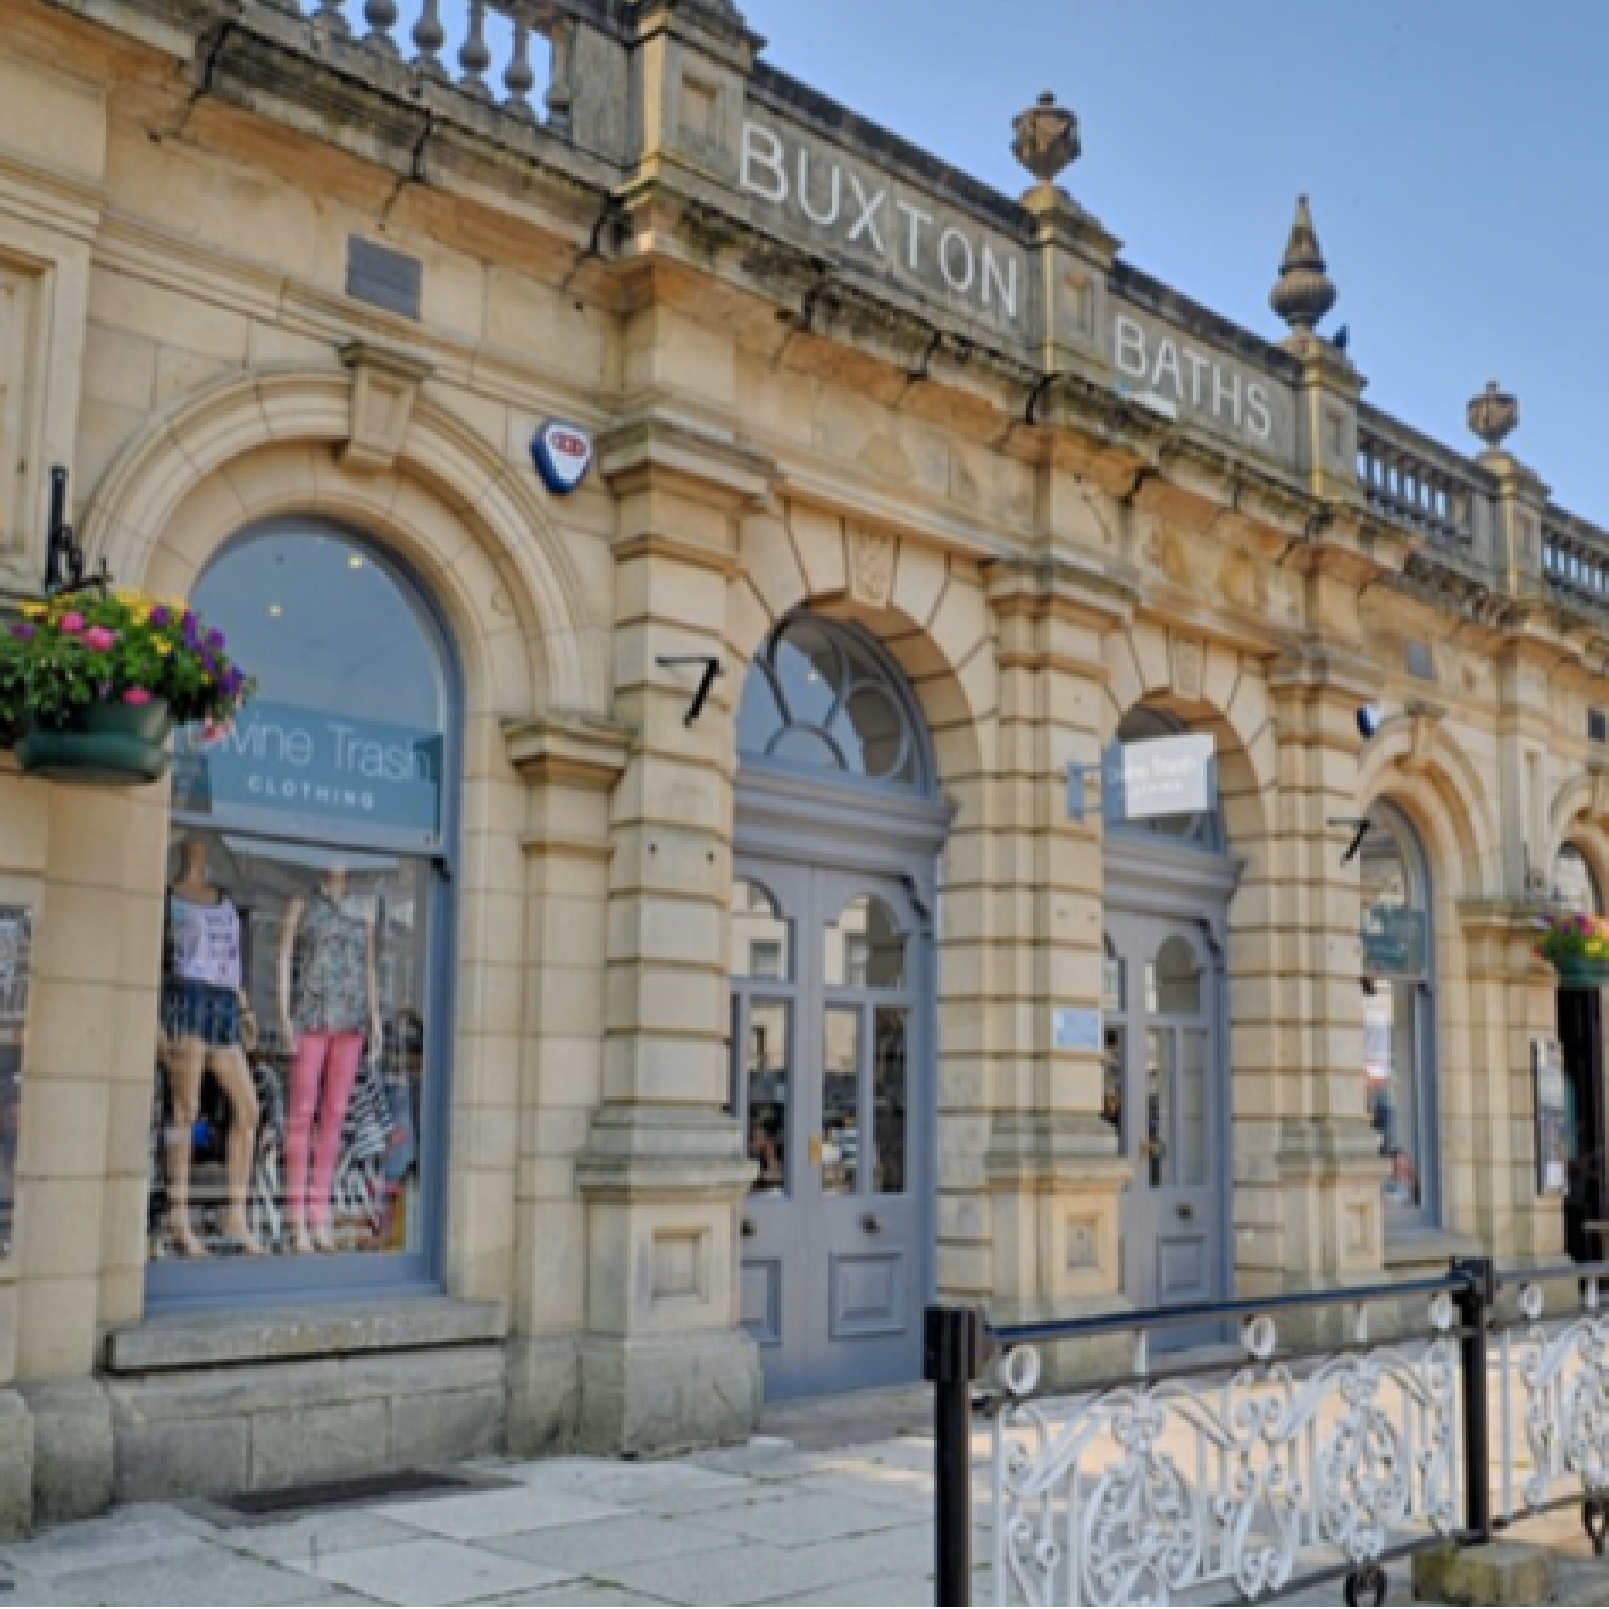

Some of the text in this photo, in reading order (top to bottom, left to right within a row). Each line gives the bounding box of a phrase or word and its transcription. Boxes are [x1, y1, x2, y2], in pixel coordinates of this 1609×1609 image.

[739, 122, 1272, 440] BUXTON BATHS
[326, 722, 430, 783] Trash
[248, 775, 375, 810] CLOTHING
